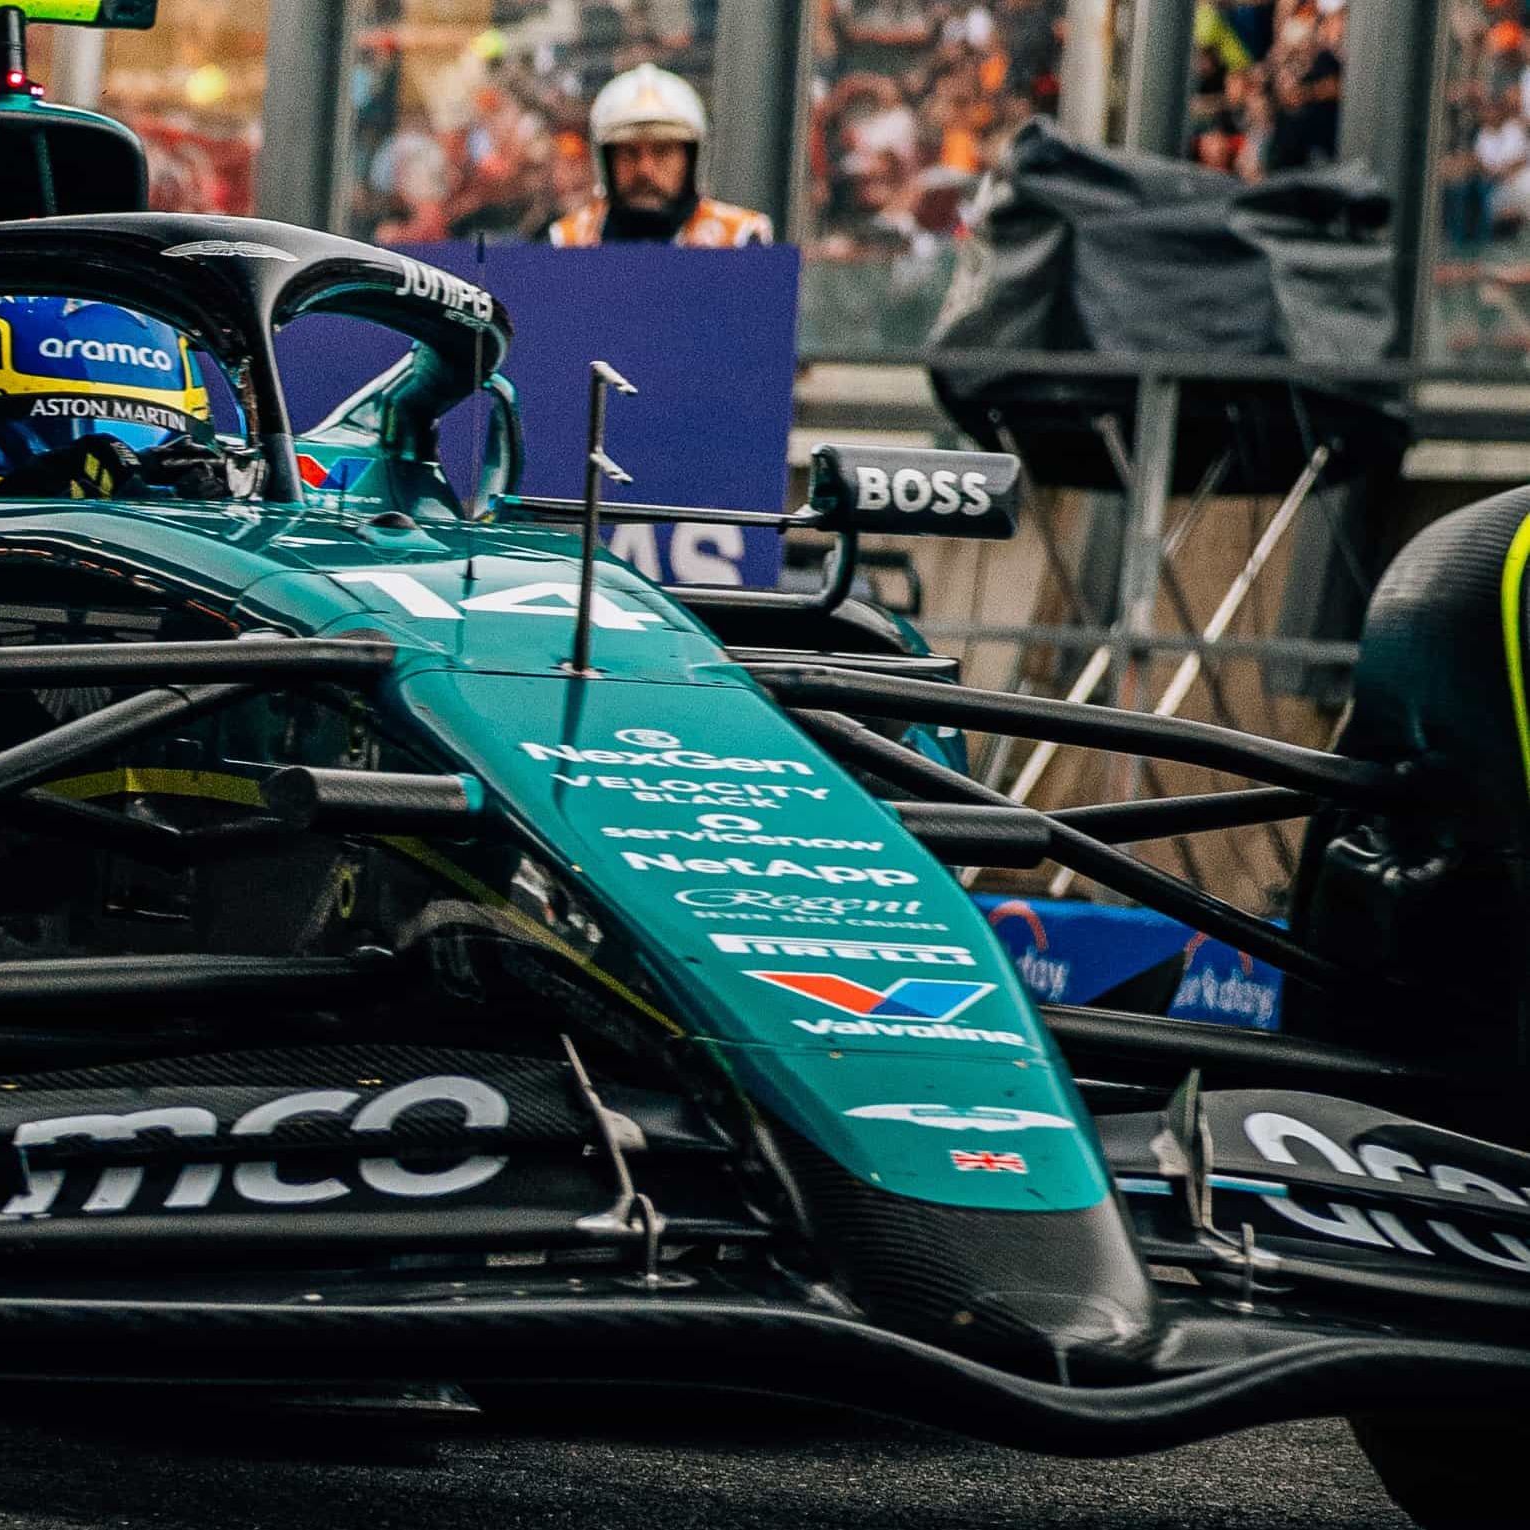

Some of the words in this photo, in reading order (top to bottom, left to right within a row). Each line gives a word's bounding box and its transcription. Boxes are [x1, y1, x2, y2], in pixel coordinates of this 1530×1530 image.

[38, 337, 174, 371] aramco
[30, 399, 107, 417] ASTON
[112, 402, 187, 432] MARTIN
[856, 466, 990, 516] BOSS
[327, 571, 664, 631] 14
[520, 742, 815, 775] NexGen
[550, 773, 830, 800] VELOCITY
[631, 791, 783, 809] BLACK
[600, 826, 884, 852] servicenow
[620, 851, 920, 887] NetApp
[673, 888, 923, 916] Regent
[707, 933, 978, 966] PIRELLI
[790, 1018, 1025, 1046] Valvoline
